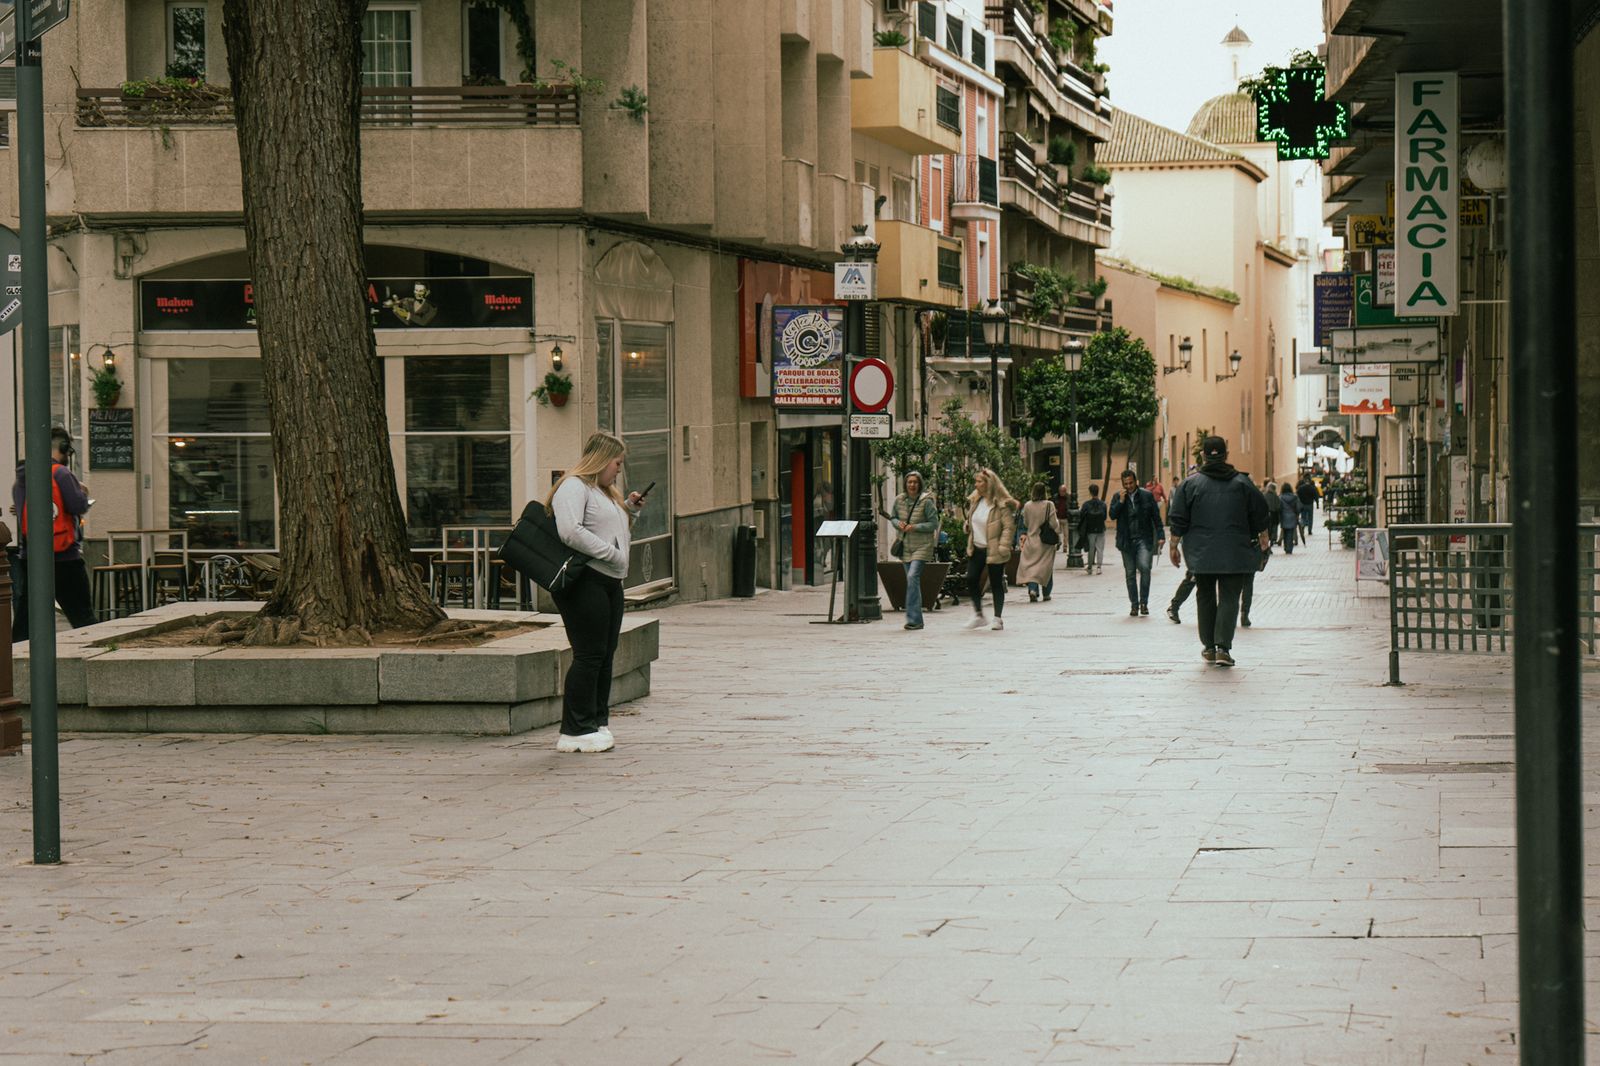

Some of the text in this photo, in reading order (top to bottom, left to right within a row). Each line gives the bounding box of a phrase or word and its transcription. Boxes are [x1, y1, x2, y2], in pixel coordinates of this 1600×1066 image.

[1404, 79, 1449, 307] FARMACIA
[156, 297, 194, 308] Mahou
[484, 294, 522, 305] Mahou
[774, 396, 796, 405] CALLE
